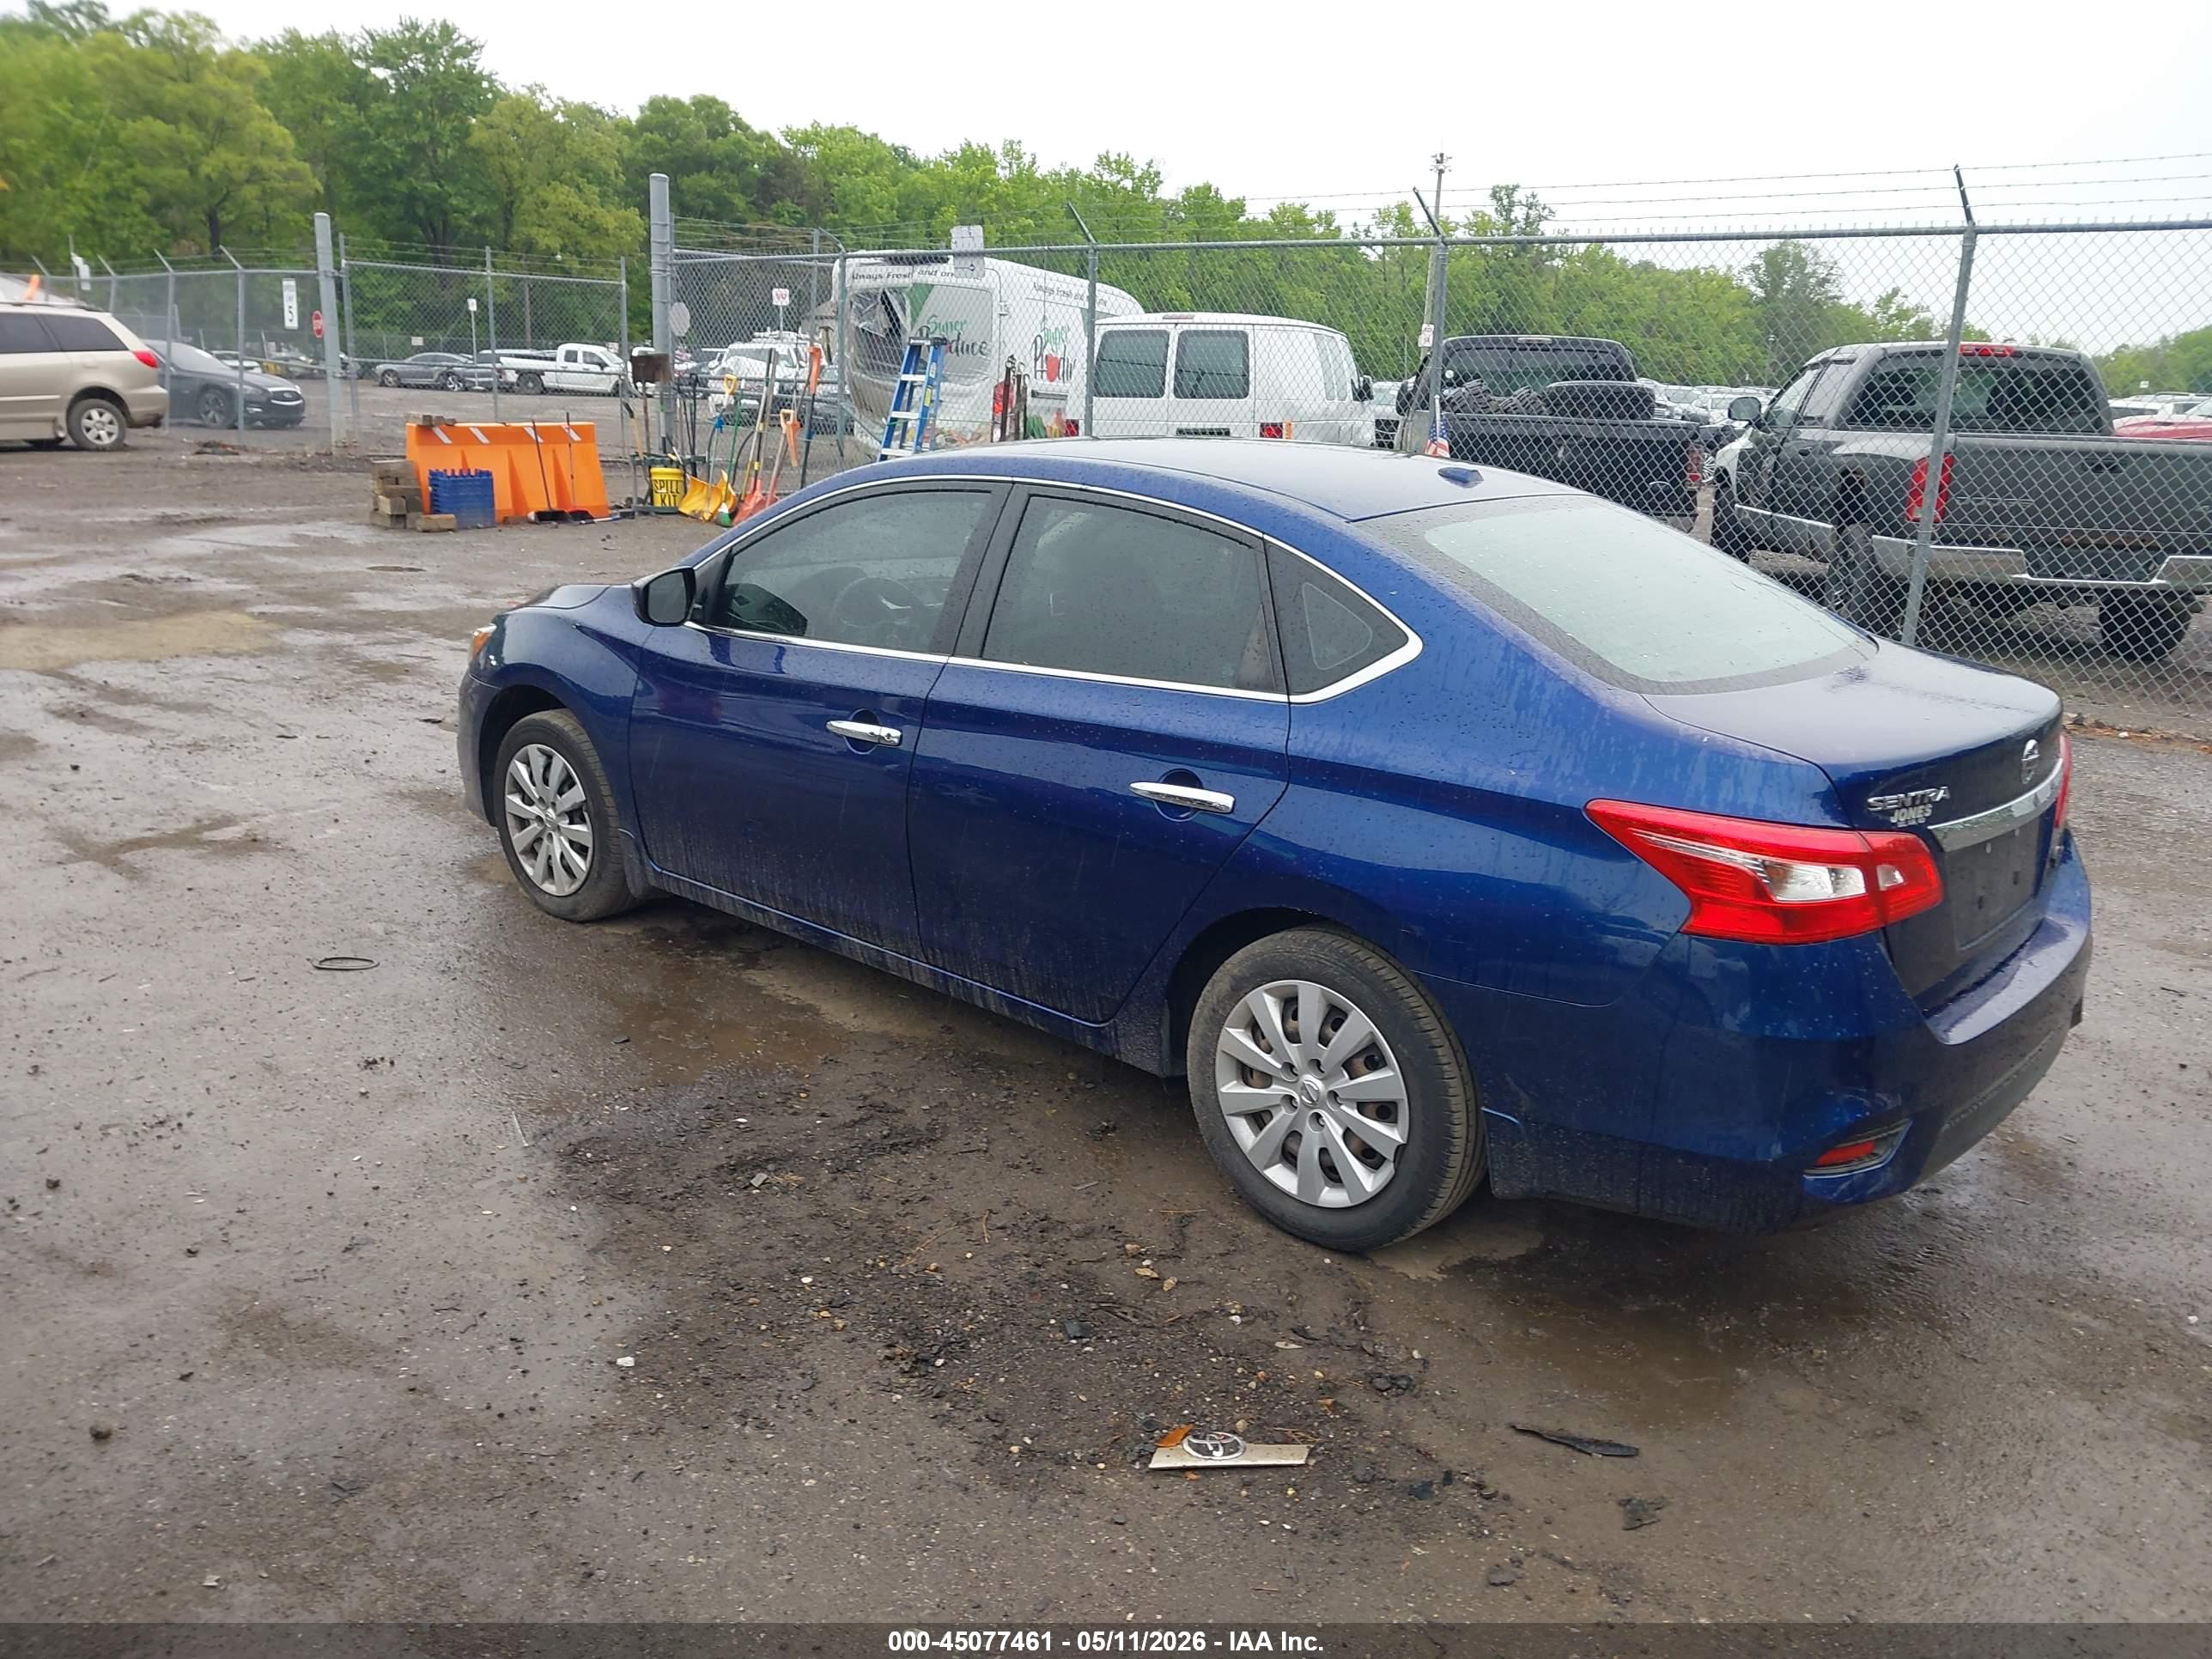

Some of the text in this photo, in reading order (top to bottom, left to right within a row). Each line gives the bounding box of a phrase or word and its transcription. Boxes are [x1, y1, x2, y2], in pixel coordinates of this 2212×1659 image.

[288, 305, 294, 323] 5
[927, 313, 967, 335] Super
[915, 325, 989, 357] Pduce
[653, 479, 680, 494] SPILL
[659, 494, 678, 507] KIT
[1867, 786, 1951, 811] SENTRA
[1889, 804, 1933, 823] JONES
